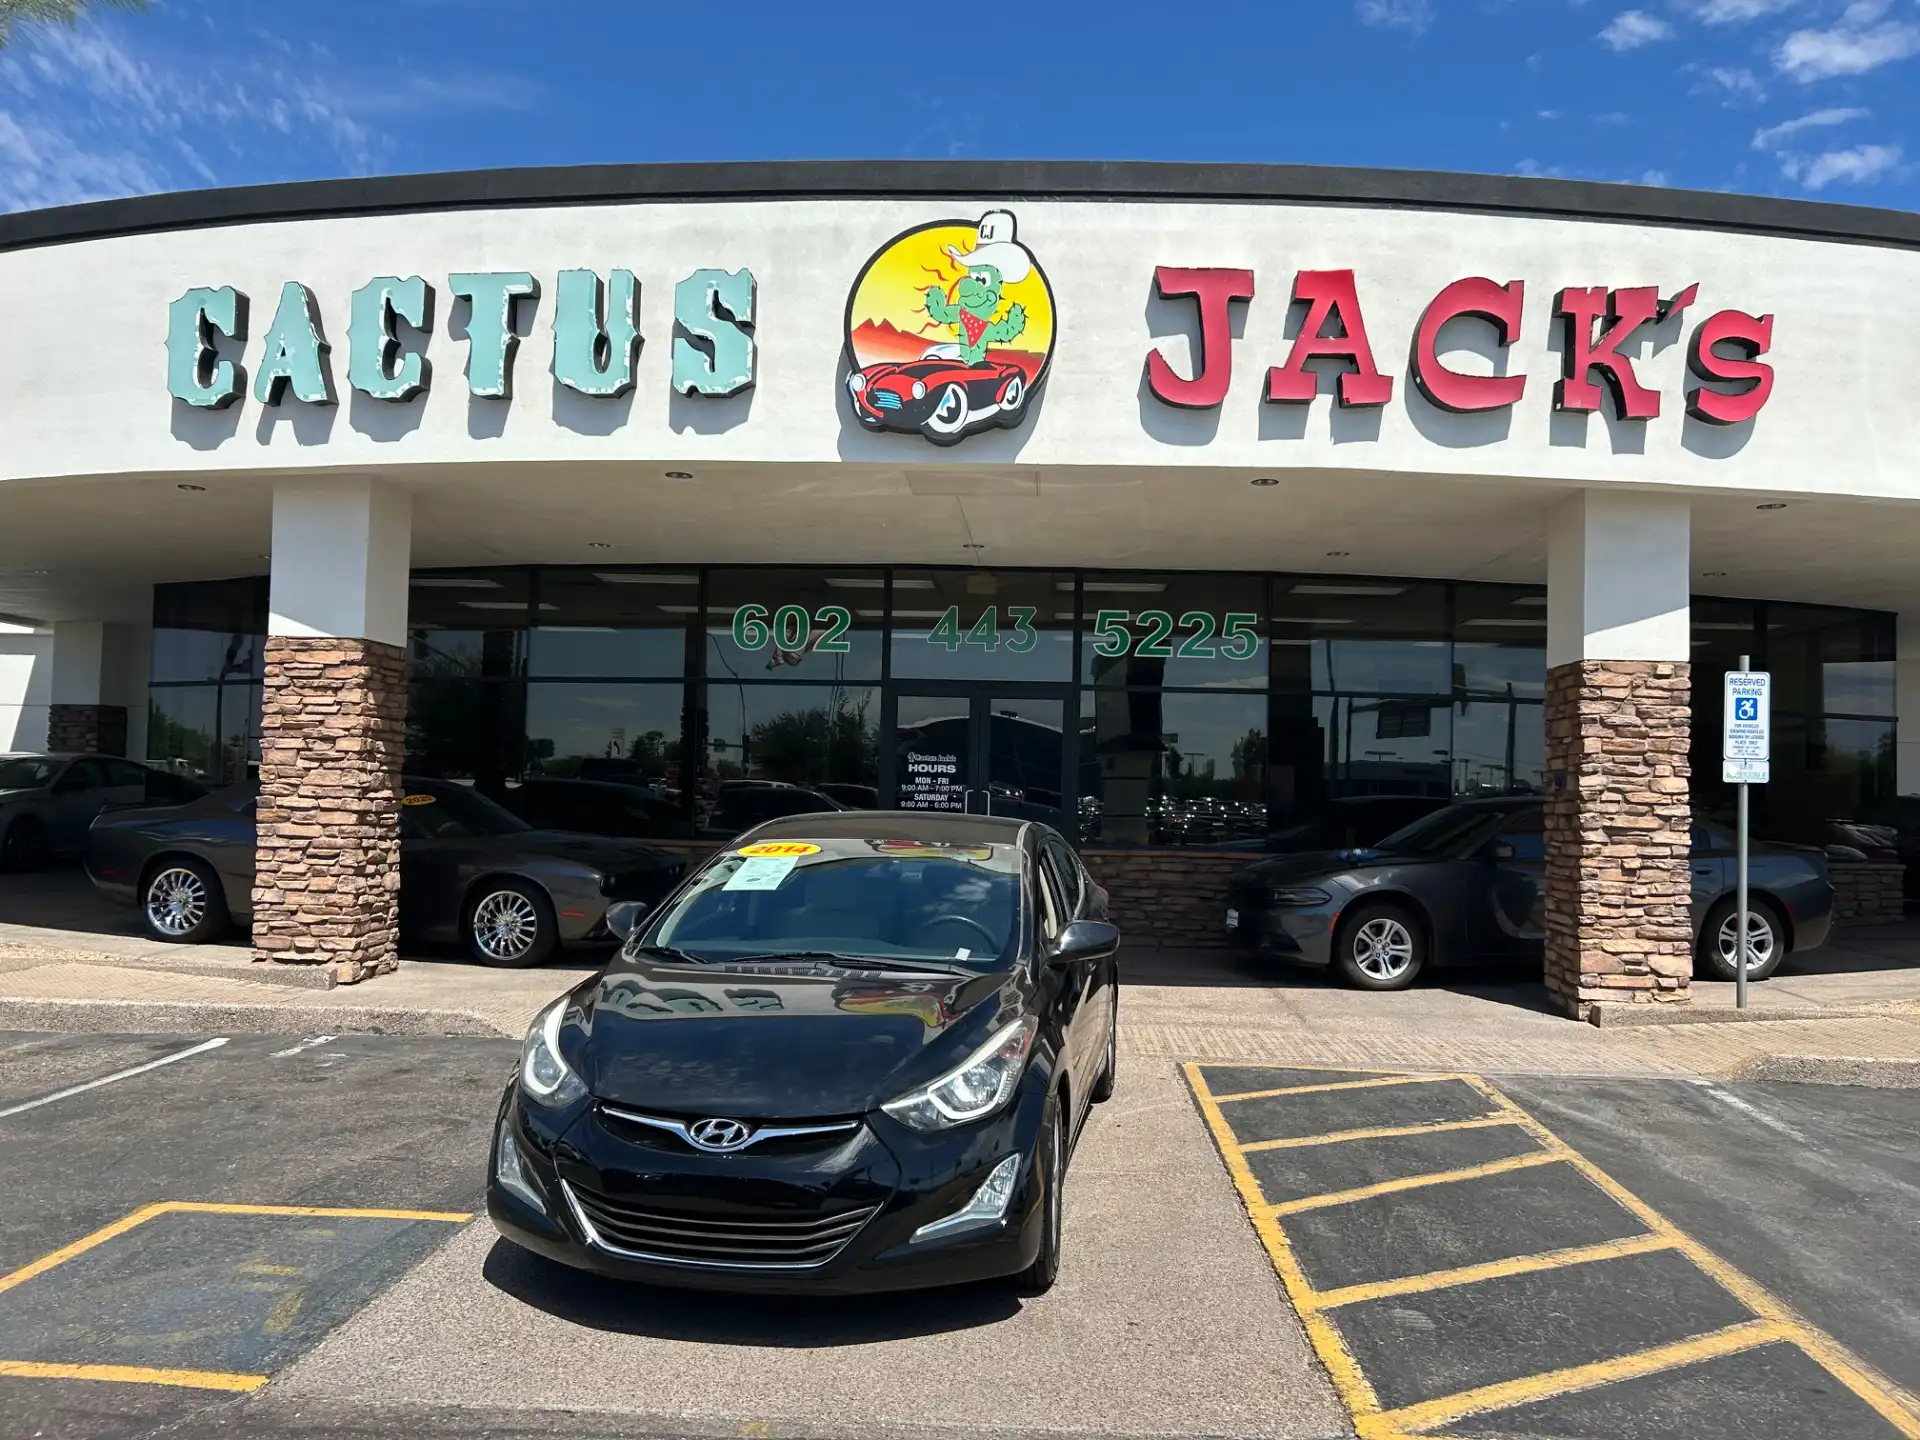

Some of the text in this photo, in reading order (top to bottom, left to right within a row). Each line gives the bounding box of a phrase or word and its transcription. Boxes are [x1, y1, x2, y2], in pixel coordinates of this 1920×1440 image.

[980, 224, 995, 240] CJ
[164, 266, 757, 410] CACTUS
[731, 603, 1260, 661] 602 443 5225
[1728, 677, 1766, 687] RESERVED
[1732, 687, 1763, 696] PARKING
[908, 763, 957, 774] HOURS
[915, 776, 931, 784] MON
[937, 777, 949, 785] FRI
[914, 793, 949, 801] SATURDAY
[747, 845, 812, 854] 2014
